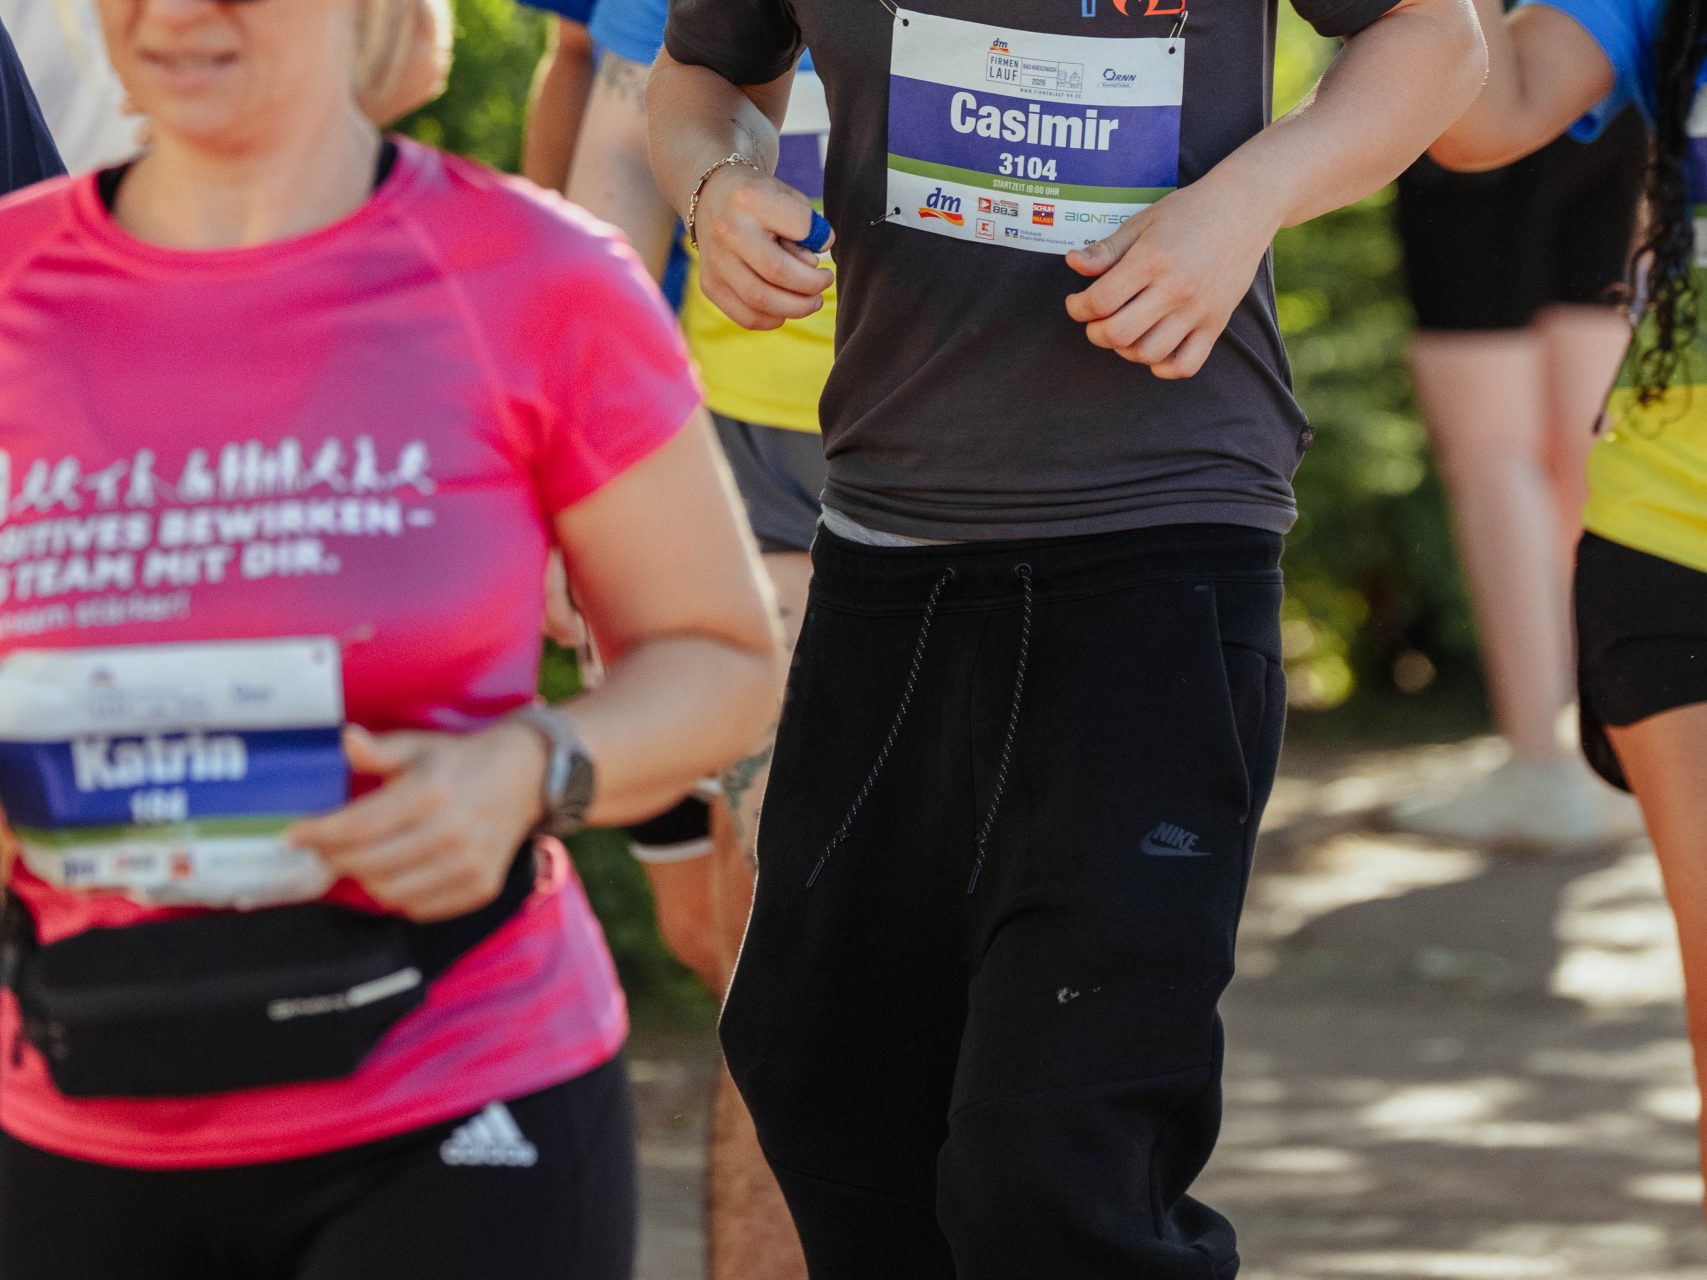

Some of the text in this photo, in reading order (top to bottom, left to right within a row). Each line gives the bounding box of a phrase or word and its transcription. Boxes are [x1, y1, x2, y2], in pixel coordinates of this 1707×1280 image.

[993, 37, 1008, 48] dm
[989, 66, 1018, 81] LAUF
[990, 56, 1019, 68] FIRMEN
[950, 91, 1119, 150] Casimir
[999, 152, 1058, 181] 3104
[926, 187, 962, 213] dm
[992, 179, 1025, 192] STARTZEIT
[1045, 186, 1060, 196] UHR
[993, 205, 1018, 217] 88.3
[14, 551, 136, 601] TEAM
[142, 544, 233, 588] MIT
[70, 733, 247, 793] Katrin
[1152, 822, 1199, 852] NIKE
